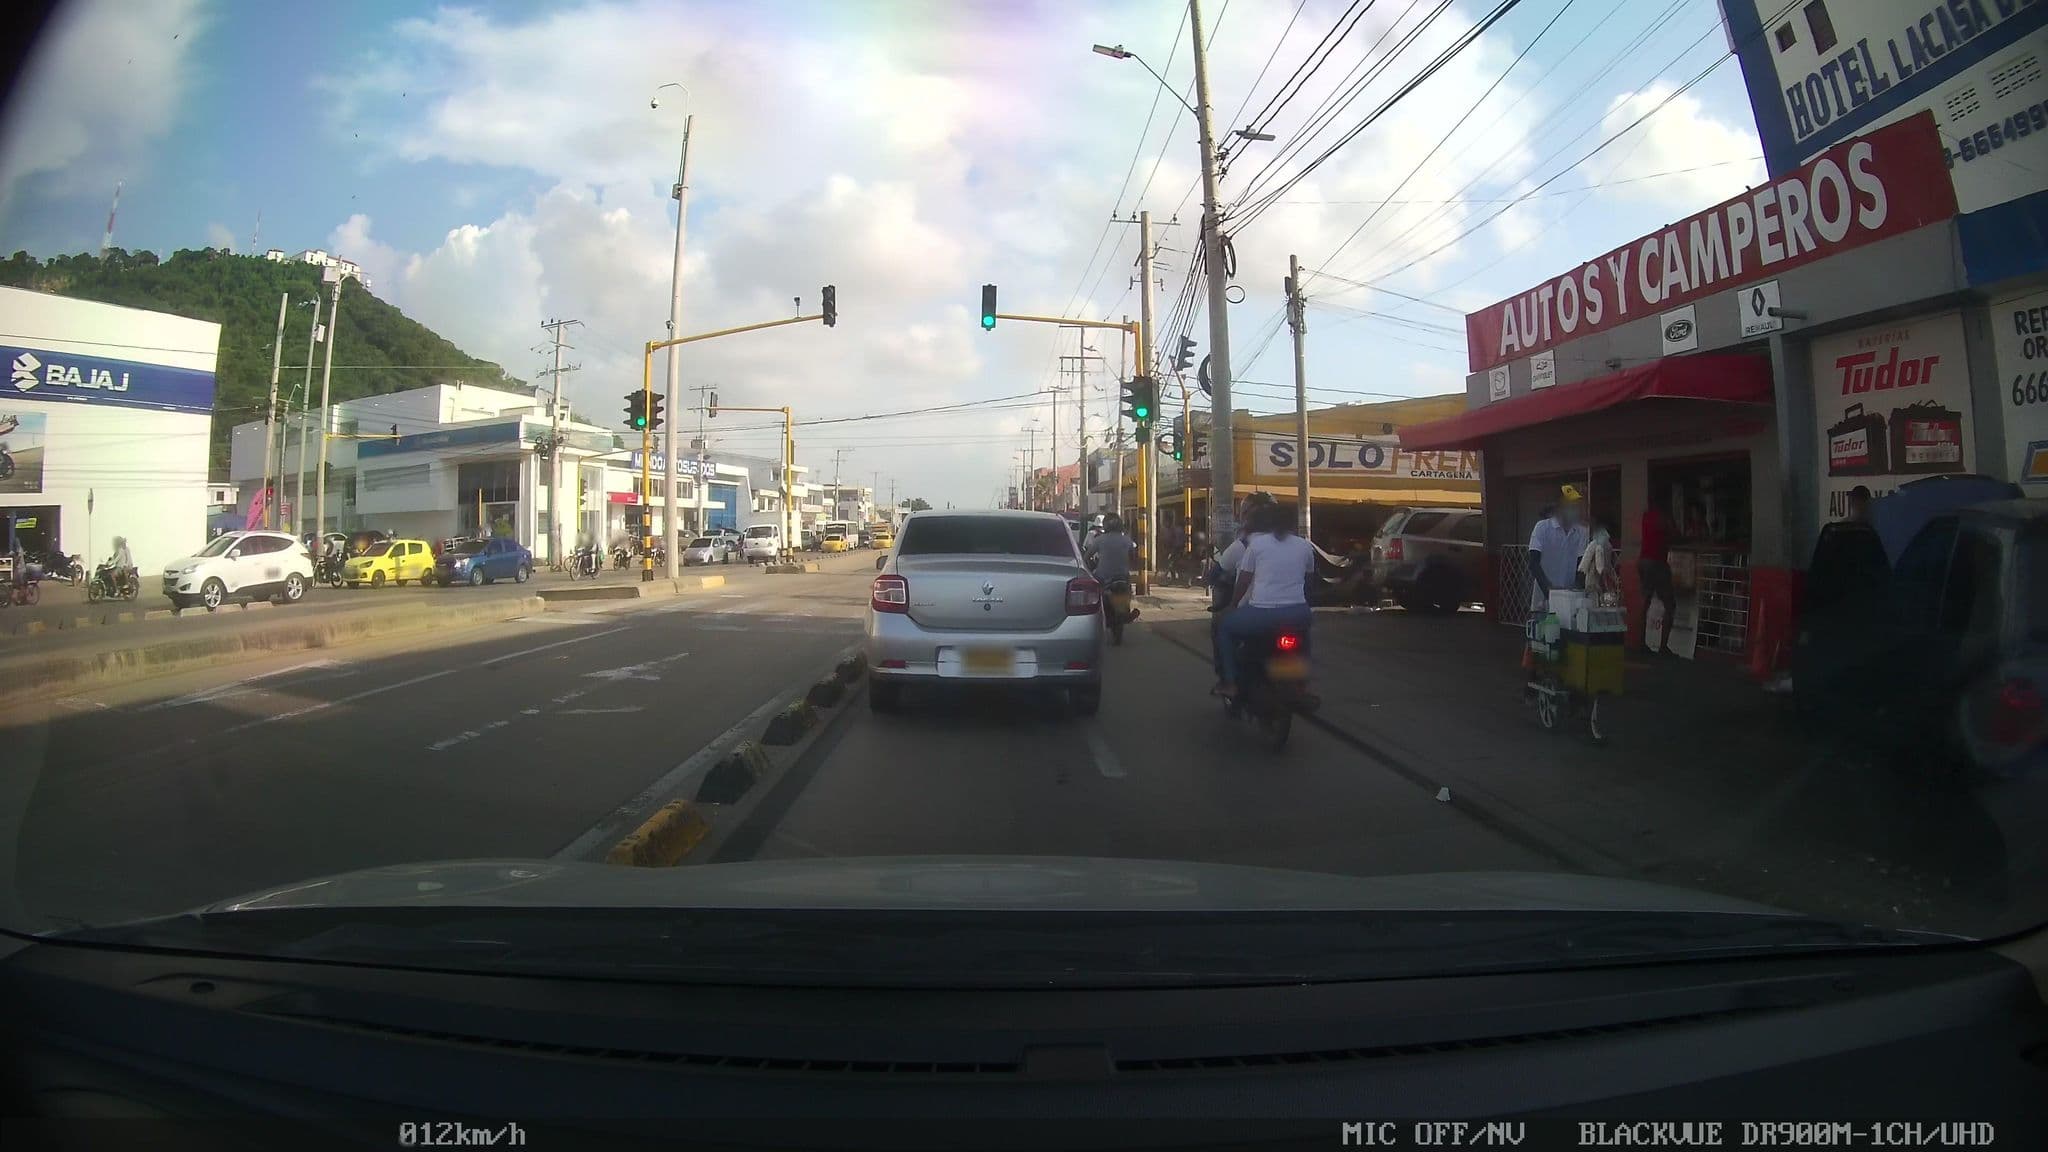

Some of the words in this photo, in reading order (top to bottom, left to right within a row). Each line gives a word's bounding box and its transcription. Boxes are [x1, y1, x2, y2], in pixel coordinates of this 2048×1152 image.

[1786, 37, 1890, 139] HOTEL
[1500, 263, 1602, 357] AUTOS
[1607, 256, 1632, 315] Y
[1638, 141, 1889, 305] CAMPEROS
[45, 363, 130, 393] BAJAJ
[1836, 347, 1940, 396] Tudor
[1410, 470, 1473, 479] CARTAGENA
